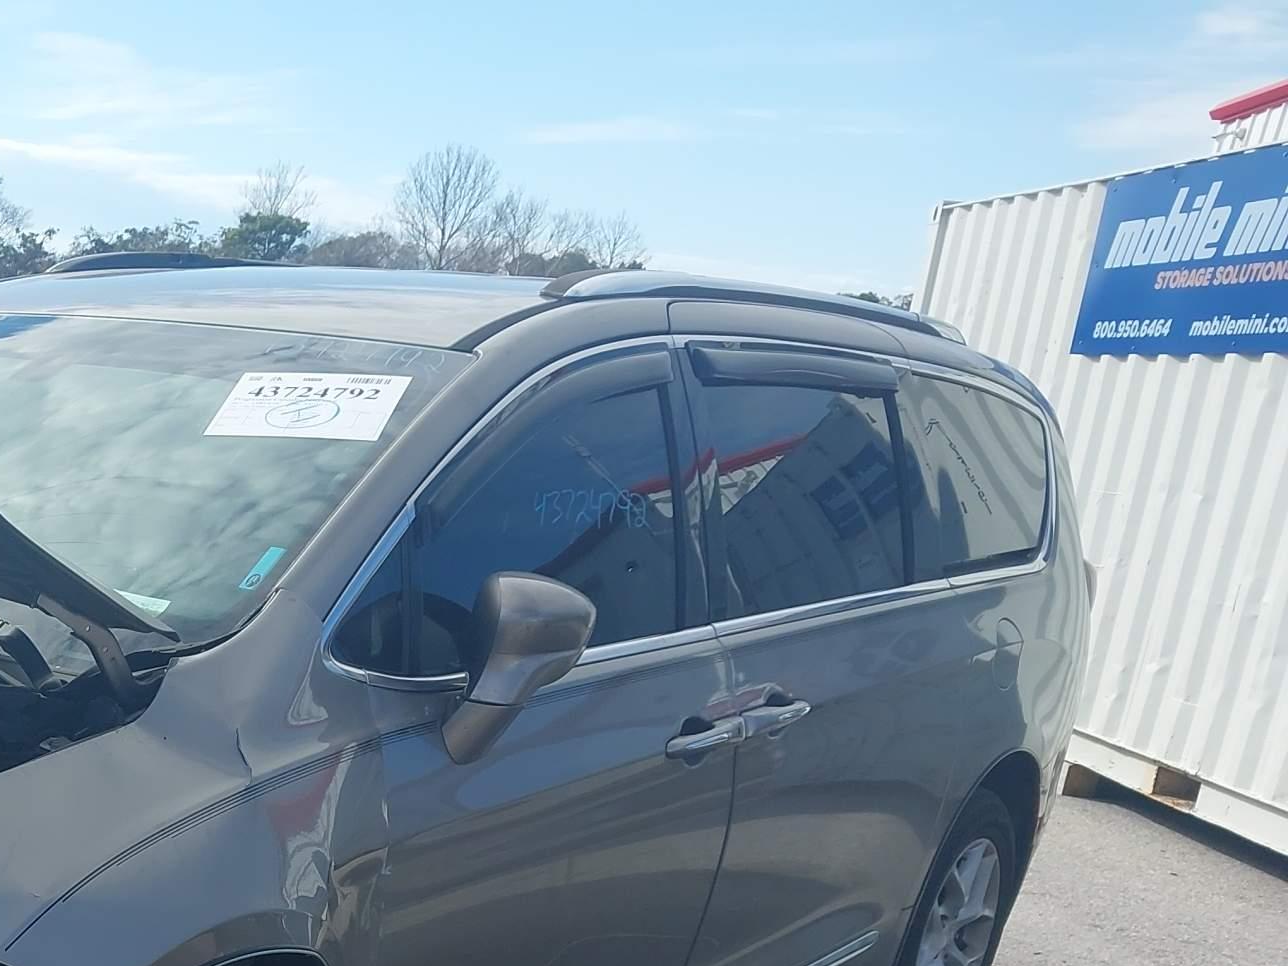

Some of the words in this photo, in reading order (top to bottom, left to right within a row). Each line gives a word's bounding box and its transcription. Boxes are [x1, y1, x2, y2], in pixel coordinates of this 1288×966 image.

[1104, 181, 1232, 269] mobile
[1223, 184, 1288, 257] mi
[1154, 266, 1214, 290] STORAGE
[1093, 318, 1173, 339] 800.950.6464
[1188, 312, 1288, 337] mobilemini.co
[248, 385, 382, 401] 43724792
